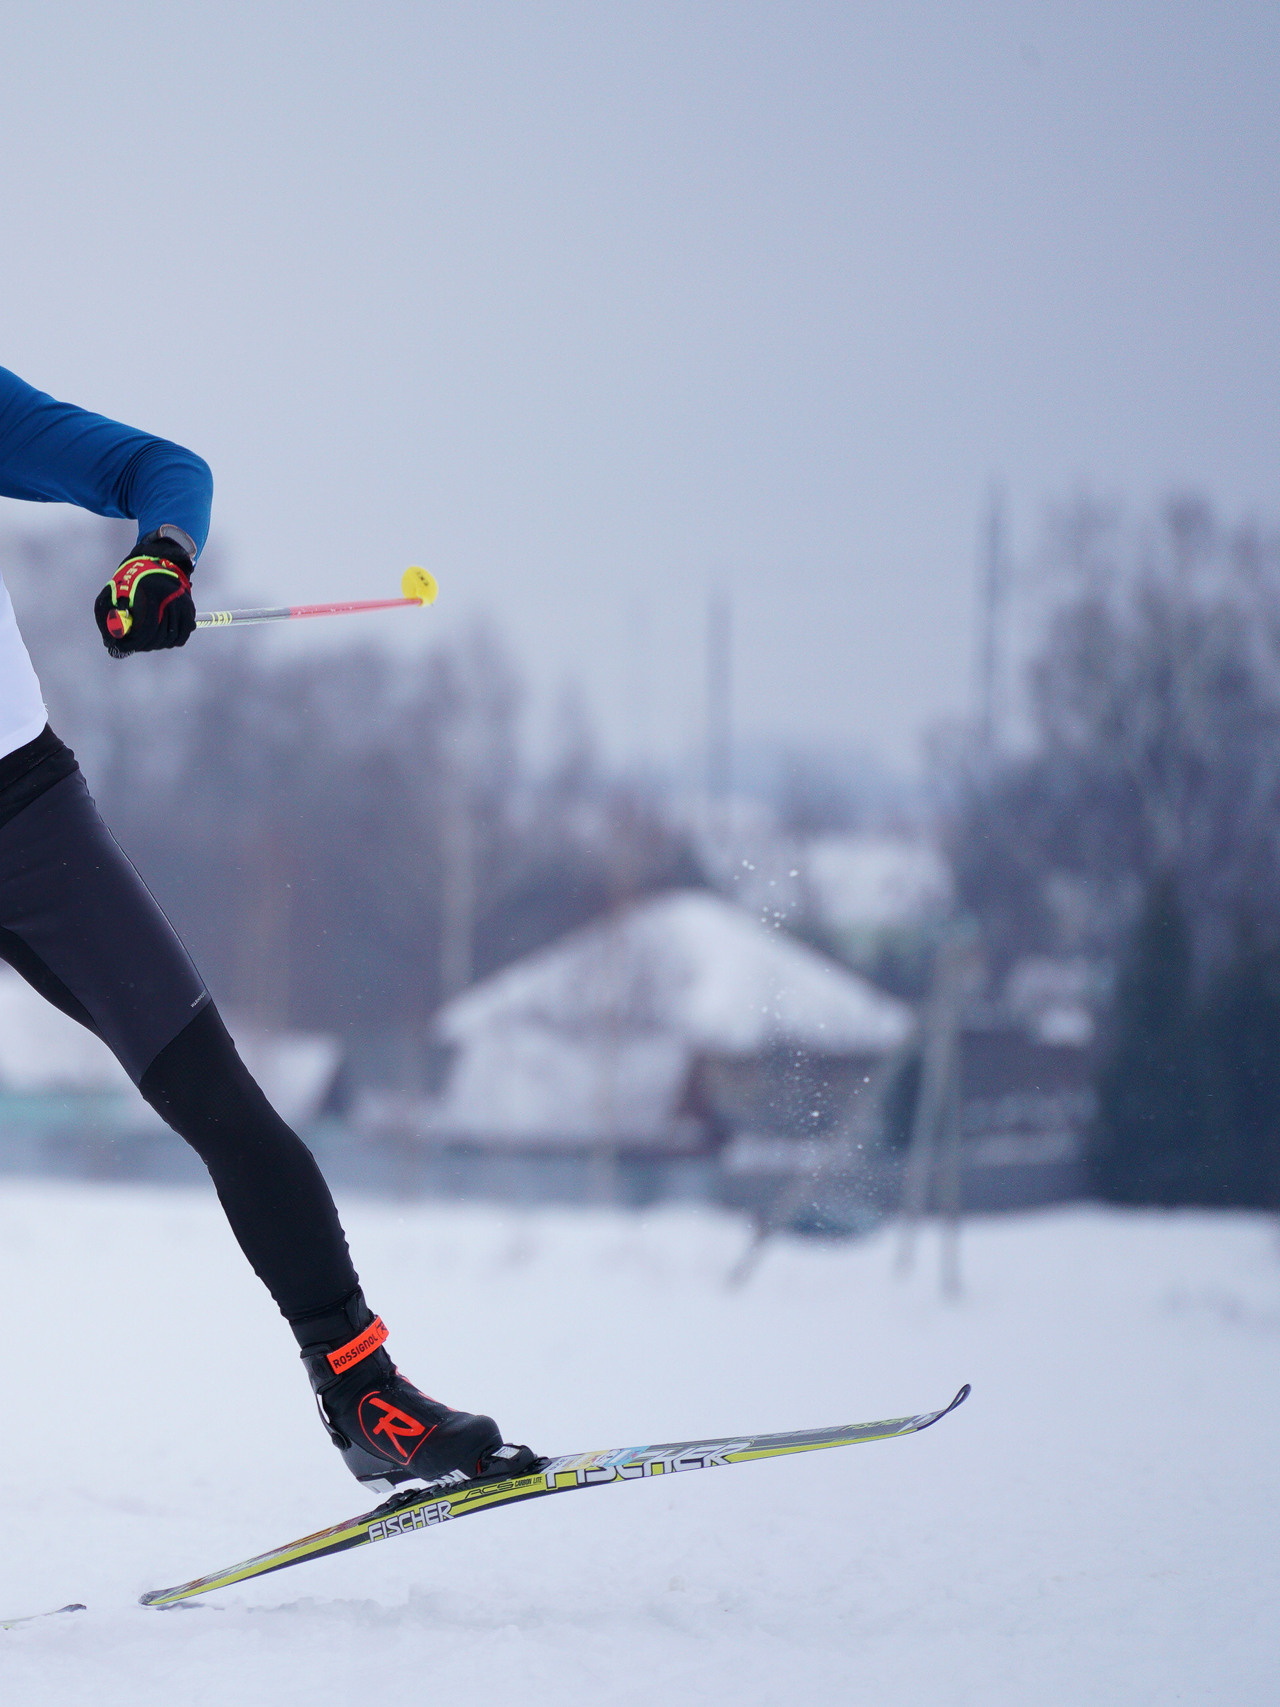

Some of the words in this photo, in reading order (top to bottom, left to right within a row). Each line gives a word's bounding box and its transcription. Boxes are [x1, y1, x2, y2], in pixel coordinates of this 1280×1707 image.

[333, 1334, 379, 1369] ROSSIGNOL
[369, 1397, 425, 1458] R
[514, 1477, 532, 1488] CARBON
[532, 1476, 543, 1485] LITE
[368, 1500, 455, 1542] FISCHER
